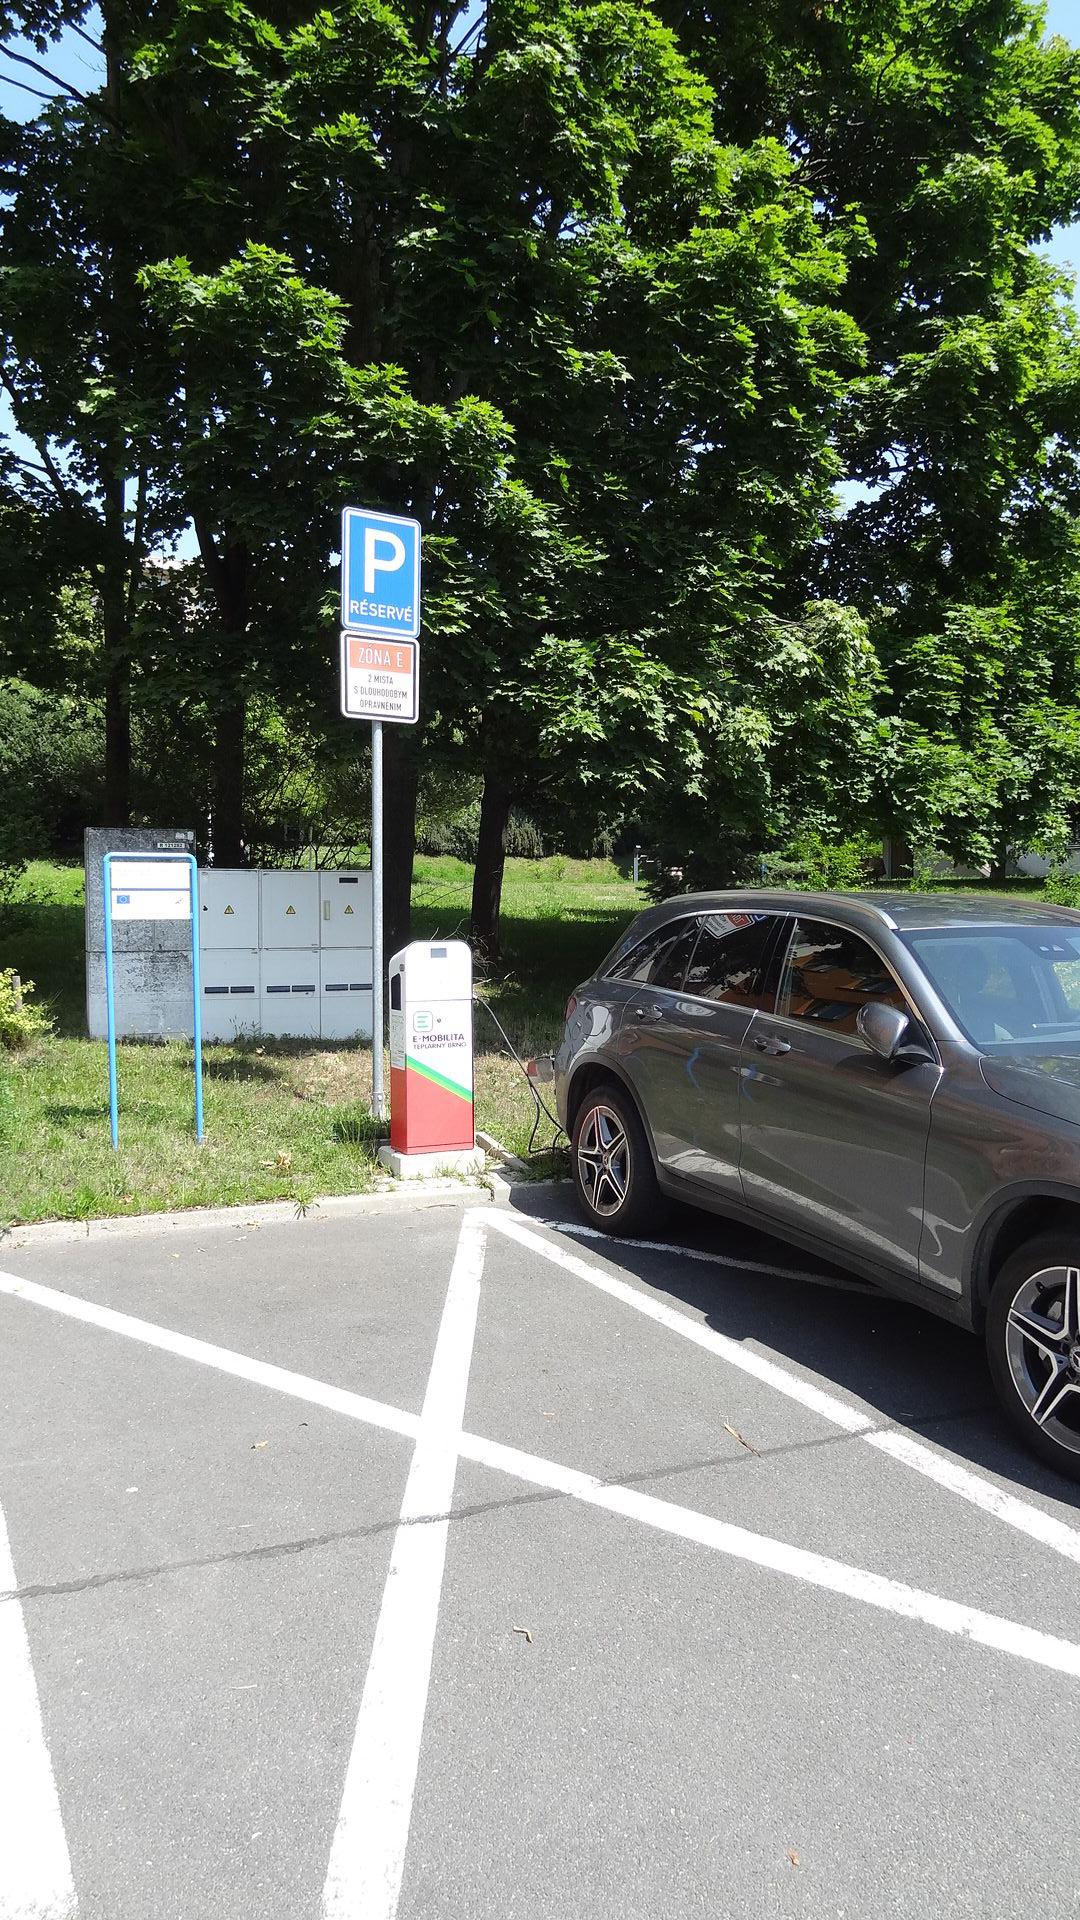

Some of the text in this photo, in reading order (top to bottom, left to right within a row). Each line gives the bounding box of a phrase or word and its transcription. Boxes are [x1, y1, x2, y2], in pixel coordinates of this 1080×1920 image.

[364, 527, 406, 594] P
[350, 598, 413, 623] RÉSERVÉ
[358, 643, 404, 668] ZÓNA E
[368, 673, 372, 683] 2
[353, 685, 359, 695] S
[412, 1033, 465, 1043] E-MOBILITA
